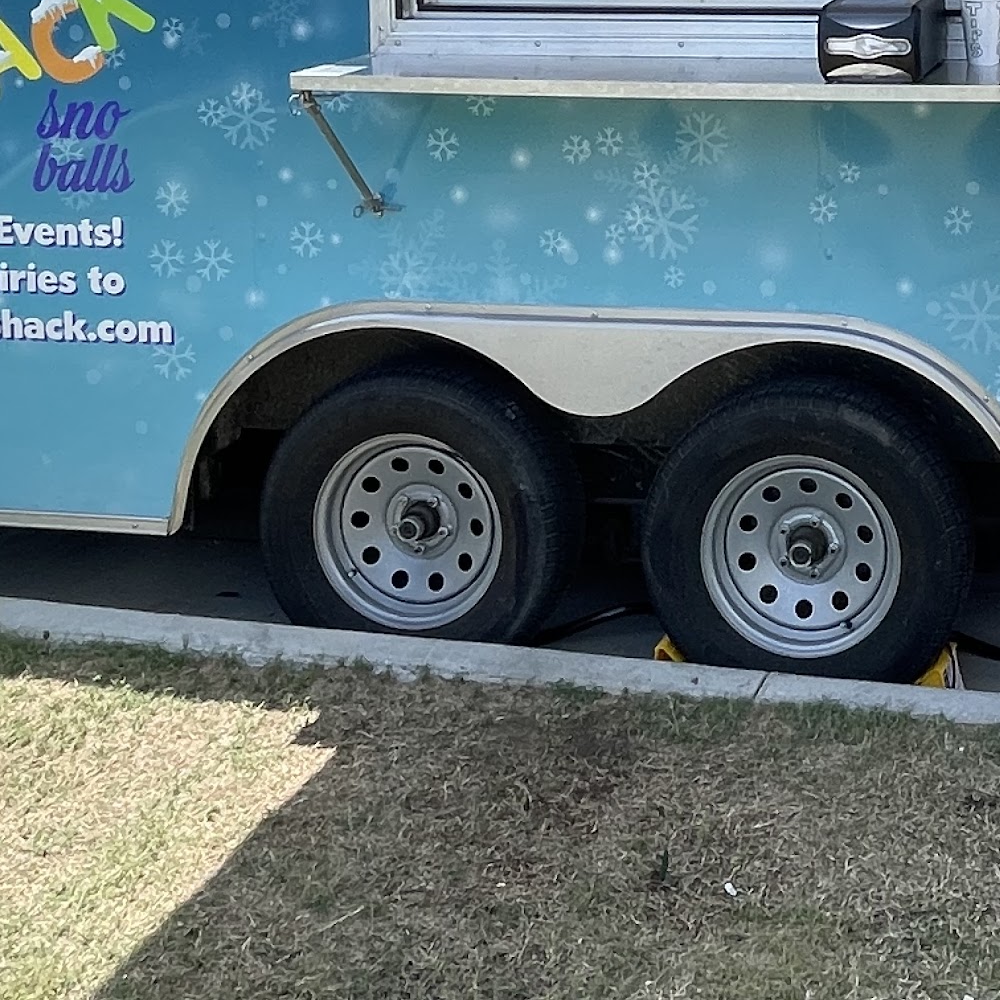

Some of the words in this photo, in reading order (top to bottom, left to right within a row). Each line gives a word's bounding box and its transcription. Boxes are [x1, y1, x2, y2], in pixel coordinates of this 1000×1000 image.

[36, 88, 132, 140] sno
[32, 143, 135, 193] balls
[88, 265, 126, 296] to
